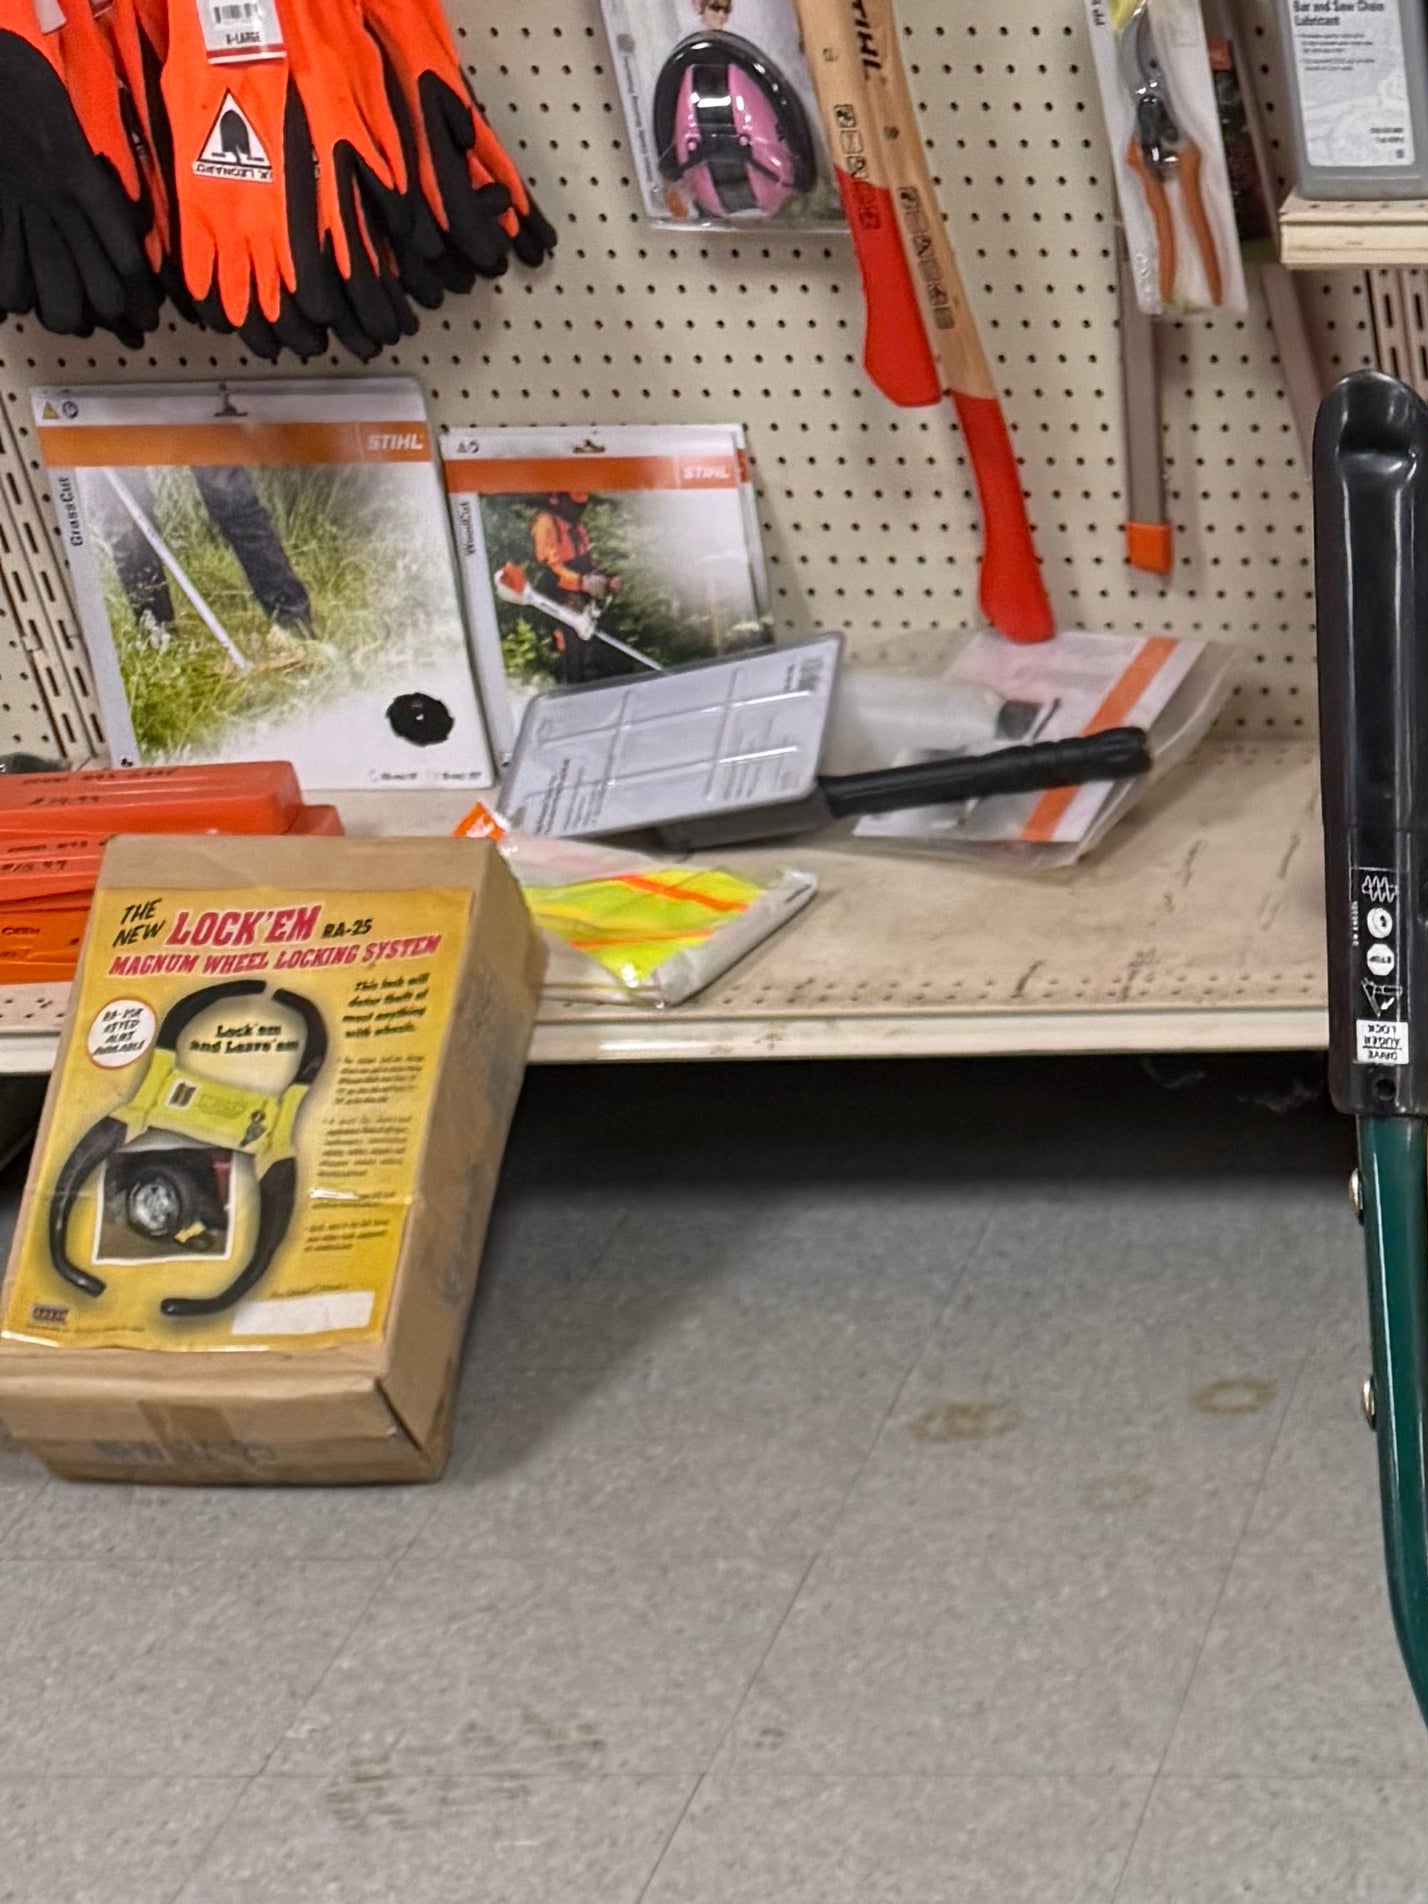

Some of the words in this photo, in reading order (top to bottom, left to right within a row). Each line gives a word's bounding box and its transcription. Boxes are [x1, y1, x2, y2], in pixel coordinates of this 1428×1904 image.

[366, 432, 425, 452] STIHL
[682, 466, 731, 481] STIHL
[58, 476, 84, 547] GrassCut
[121, 899, 162, 925] THE
[164, 903, 323, 947] LOCK'EM
[321, 918, 374, 939] RA-25
[112, 920, 167, 948] NEW
[107, 953, 202, 977] MAGNUM
[201, 951, 271, 975] WHEEL
[272, 943, 360, 971] LOCKING
[361, 934, 444, 964] SYSTEM
